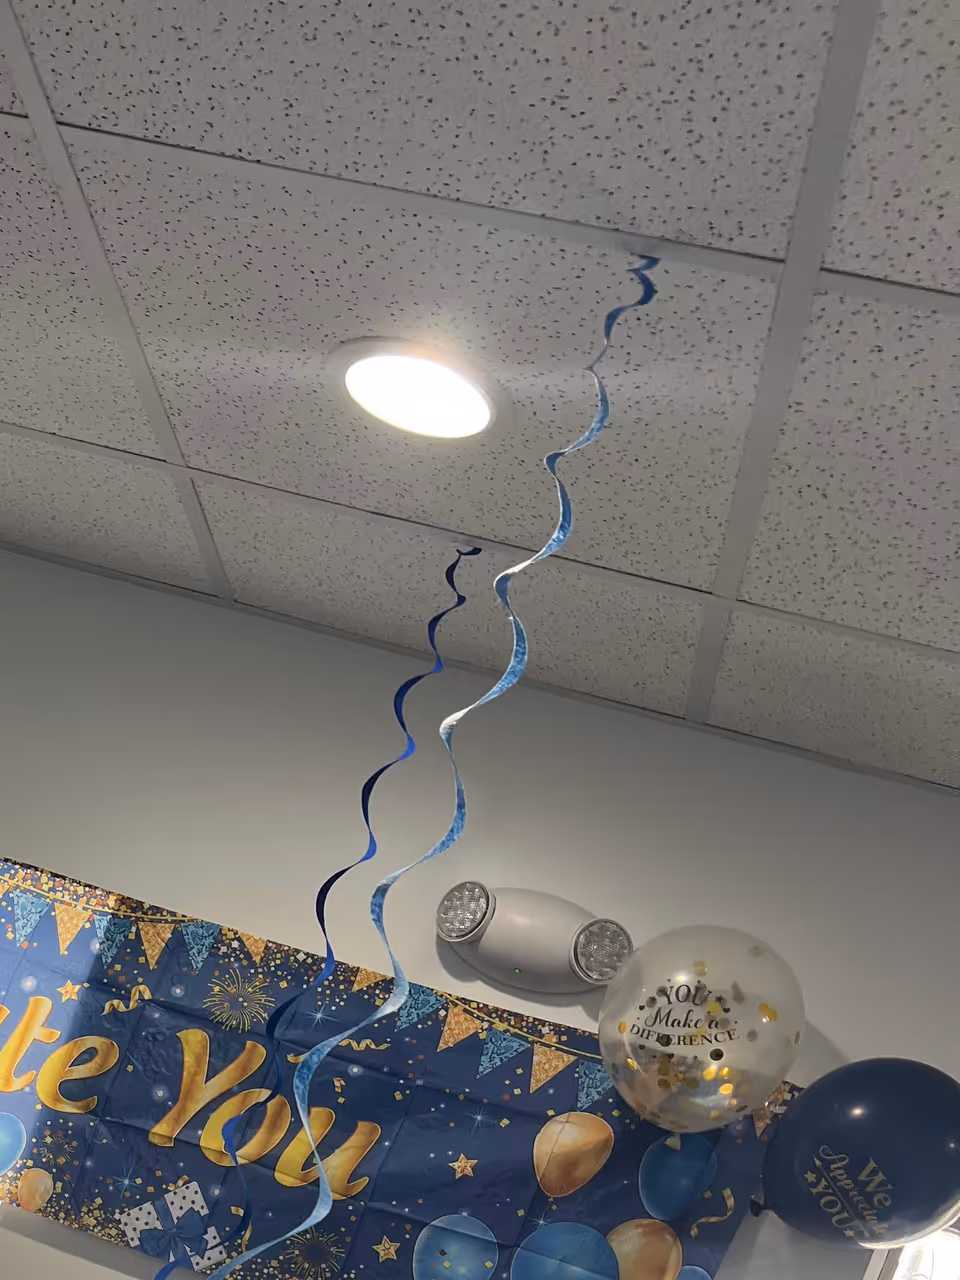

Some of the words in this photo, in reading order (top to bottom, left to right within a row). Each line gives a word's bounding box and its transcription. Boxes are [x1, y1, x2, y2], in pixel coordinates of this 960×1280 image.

[645, 1006, 704, 1029] Make
[708, 1019, 720, 1030] a
[661, 984, 712, 1006] YOU
[149, 1028, 382, 1200] You
[809, 1177, 858, 1228] YOU
[858, 1157, 893, 1208] We
